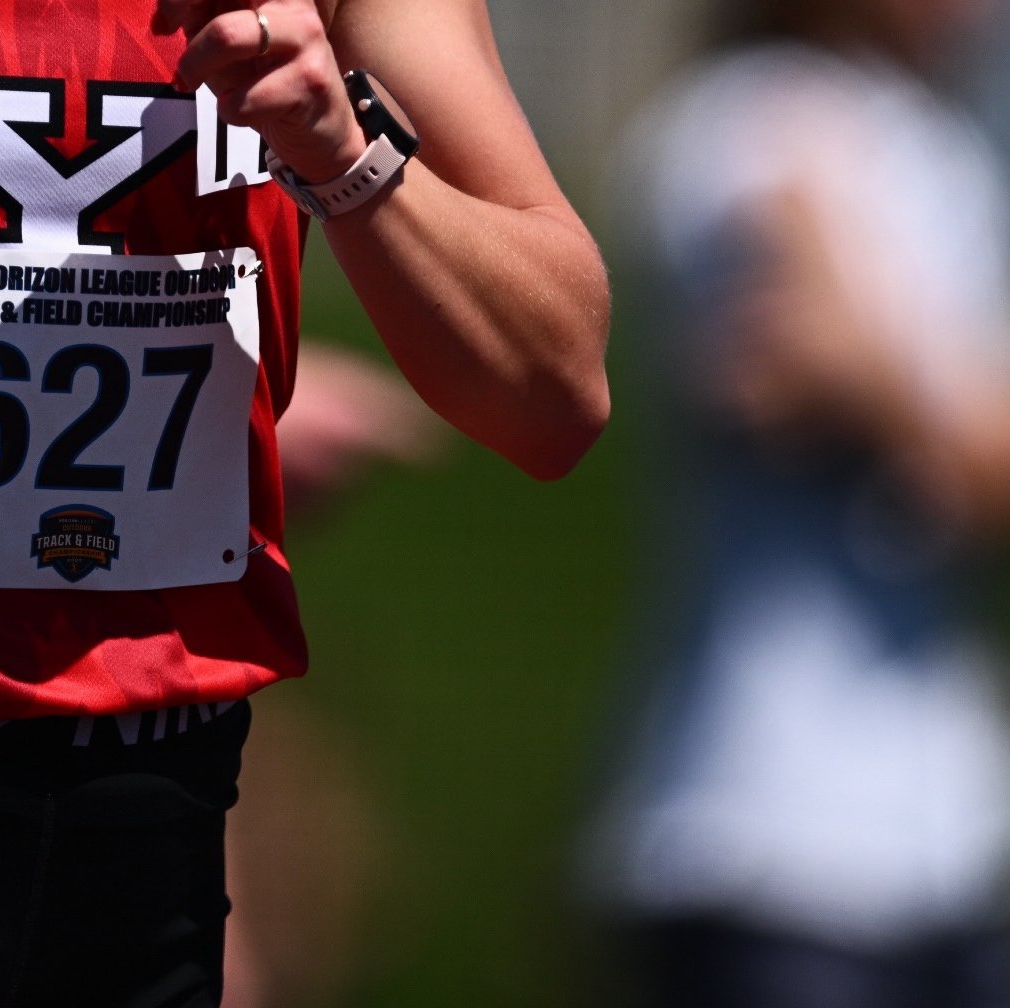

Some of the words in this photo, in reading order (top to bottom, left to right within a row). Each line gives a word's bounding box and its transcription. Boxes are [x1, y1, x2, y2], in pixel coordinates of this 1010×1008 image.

[80, 268, 161, 296] LEAGUE
[164, 264, 236, 295] OUTDOOR
[0, 300, 18, 323] &
[23, 298, 82, 326] FIELD
[87, 296, 231, 328] CHAMPIONSHIP
[37, 533, 72, 550] TRACK
[75, 533, 83, 547] &
[86, 534, 115, 551] FIELD
